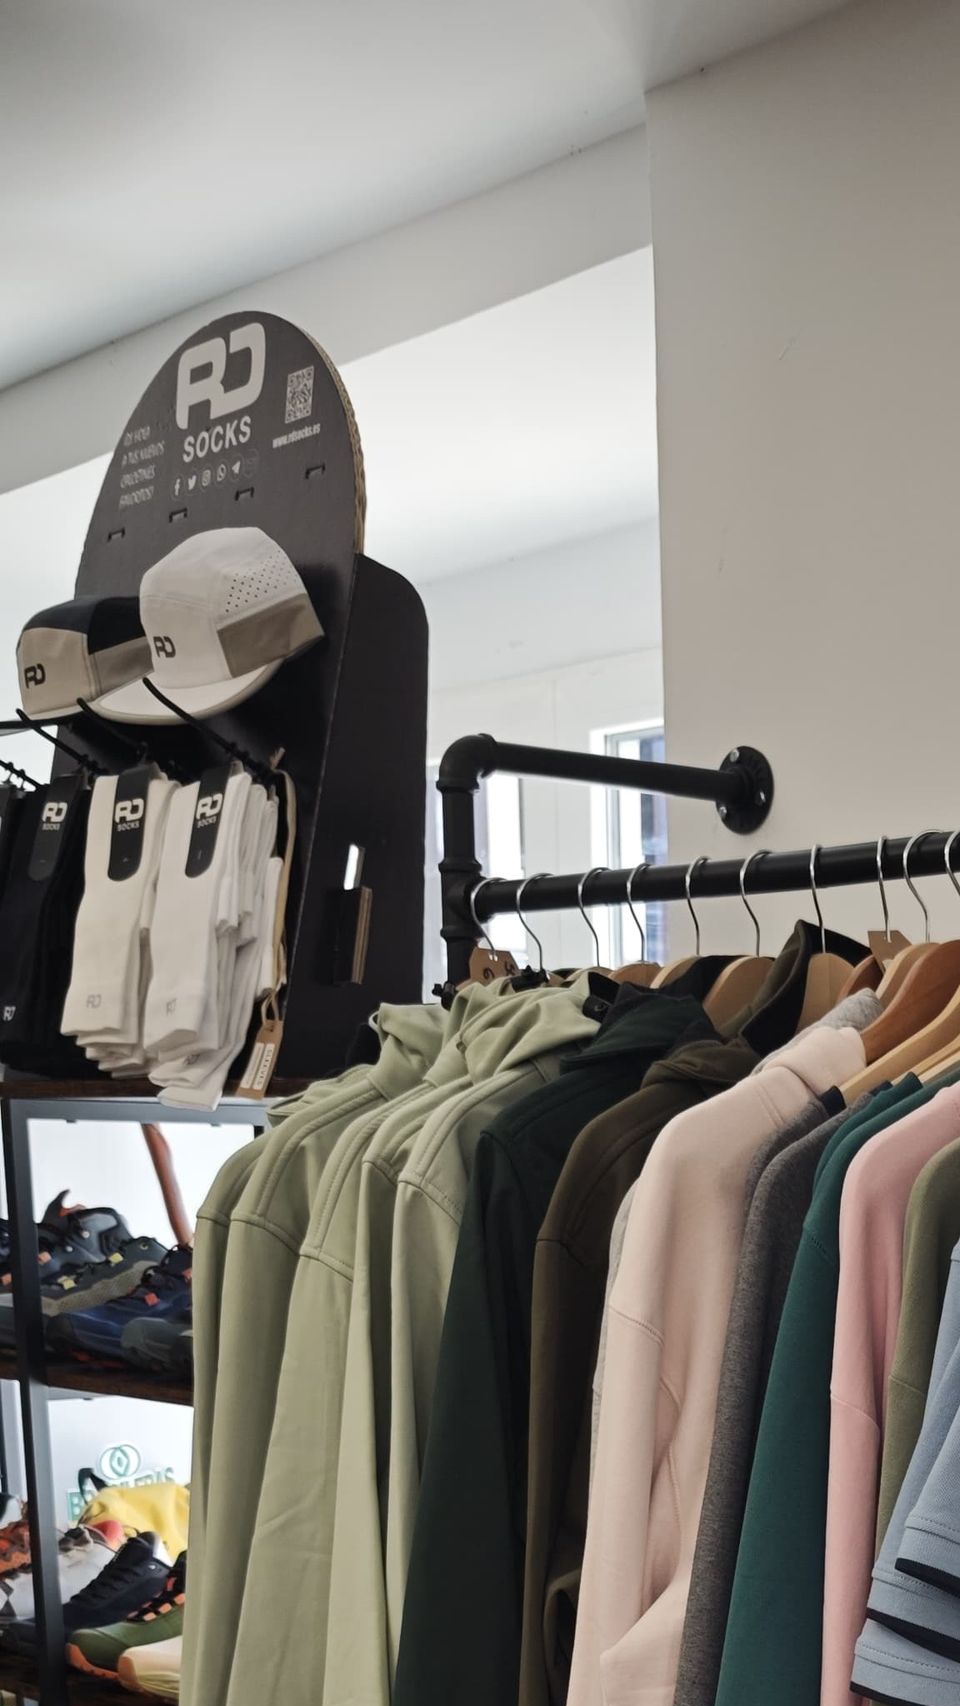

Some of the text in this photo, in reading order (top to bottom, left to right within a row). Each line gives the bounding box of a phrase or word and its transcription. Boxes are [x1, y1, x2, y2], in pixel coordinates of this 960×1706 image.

[176, 322, 266, 430] RD
[183, 416, 252, 463] SOCKS
[153, 635, 176, 658] RD
[24, 663, 46, 689] RD
[42, 802, 68, 822] RD
[115, 799, 144, 823] RD
[196, 793, 223, 820] RD
